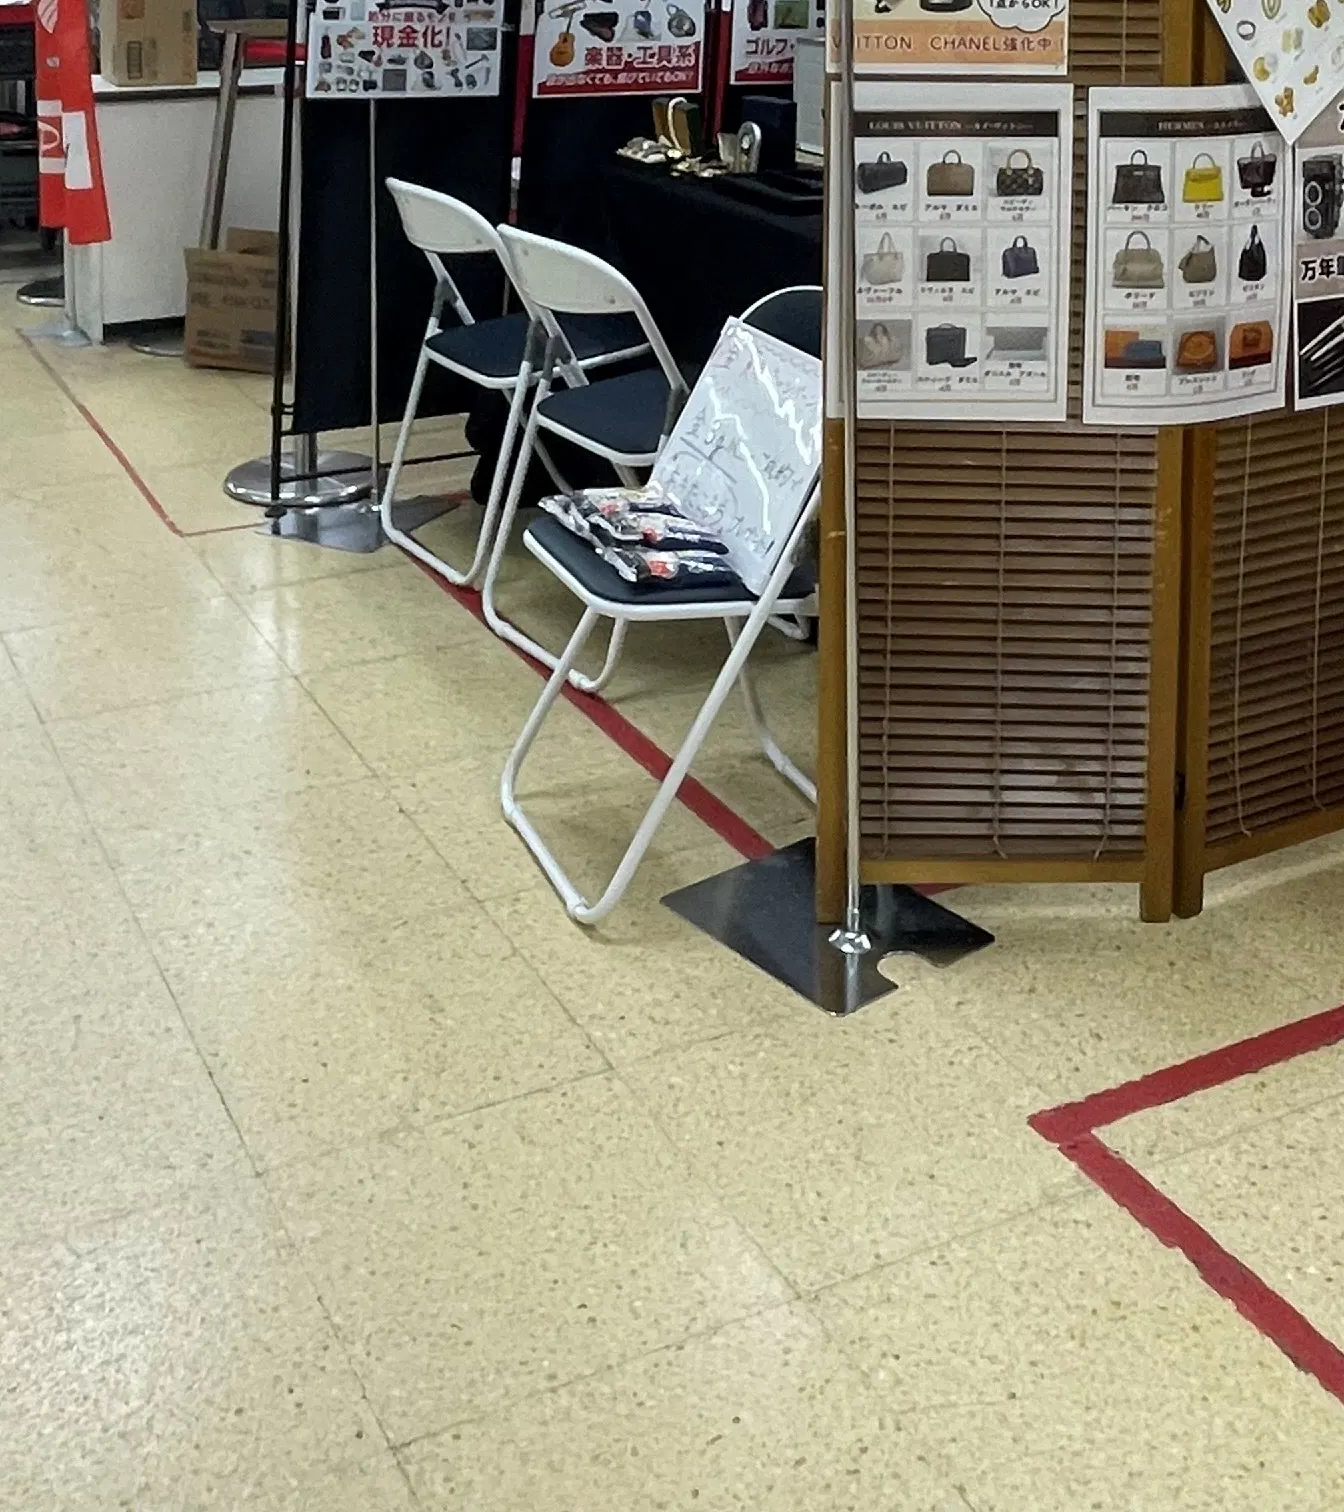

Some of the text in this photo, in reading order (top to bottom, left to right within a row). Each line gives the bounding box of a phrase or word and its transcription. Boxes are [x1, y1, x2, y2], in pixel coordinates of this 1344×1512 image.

[373, 24, 451, 48] 現金化!
[584, 43, 697, 68] 楽器・工具系
